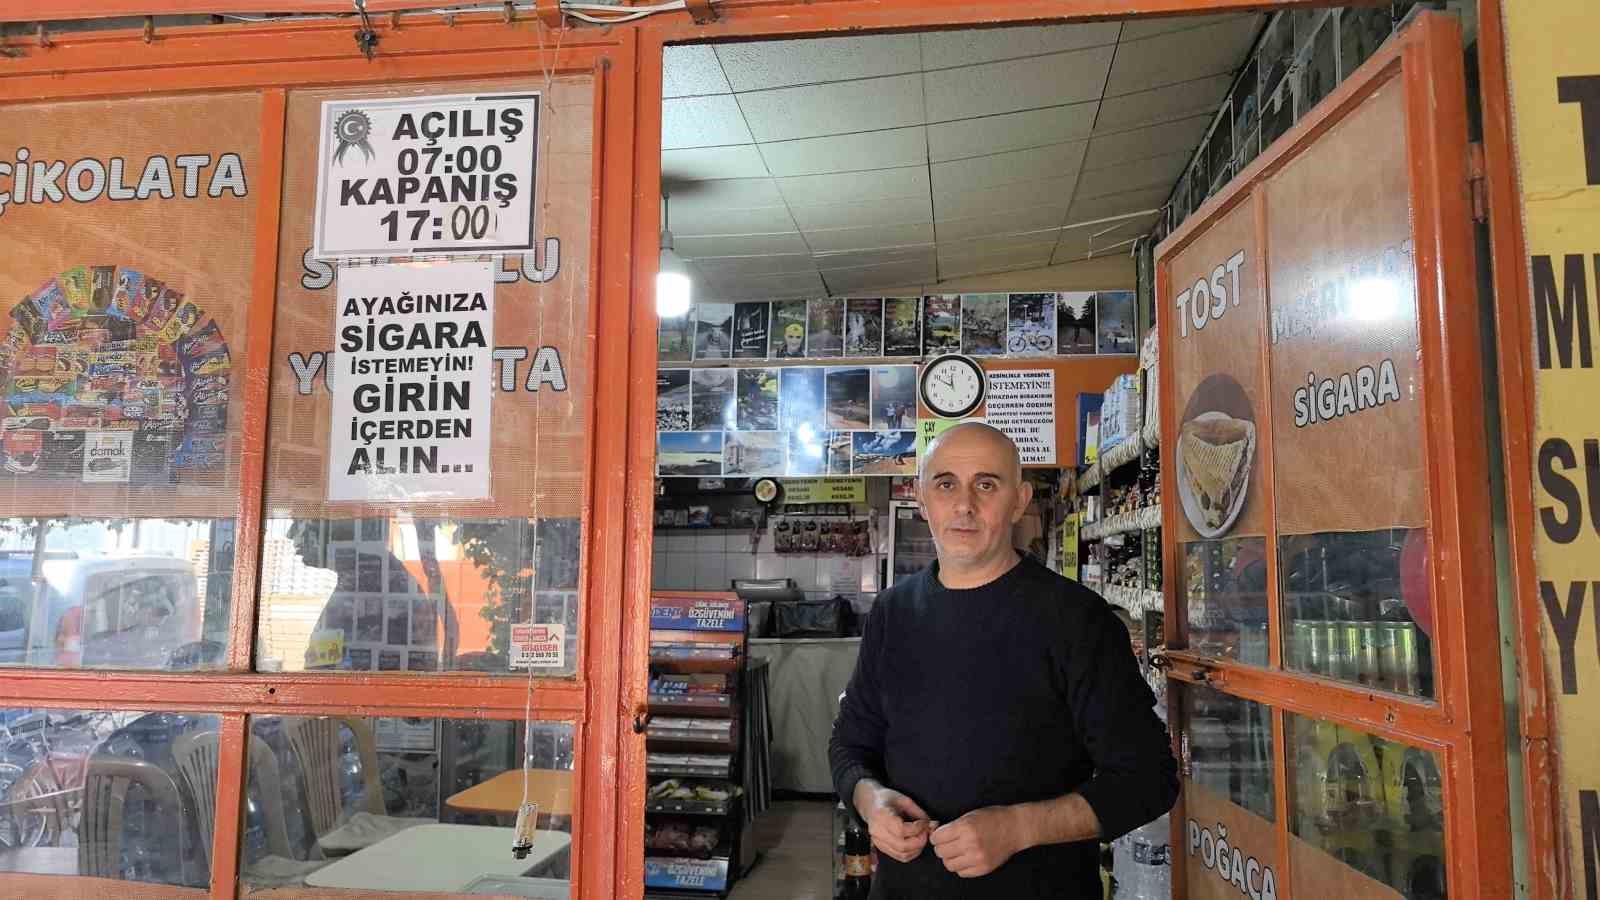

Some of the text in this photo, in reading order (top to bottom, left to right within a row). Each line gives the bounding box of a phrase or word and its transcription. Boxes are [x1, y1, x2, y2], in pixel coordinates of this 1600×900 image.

[391, 107, 524, 144] AÇILIŞ
[397, 144, 503, 176] 07:00
[340, 173, 518, 208] KAPANIŞ
[342, 291, 487, 317] AYAĞINIZA
[1175, 249, 1245, 338] TOST
[340, 317, 487, 353] SİGARA
[350, 355, 474, 376] İSTEMEYİN!
[352, 374, 471, 414] GİRİN
[1293, 357, 1401, 429] SİGARA
[351, 418, 473, 444] İÇERDEN
[346, 445, 474, 475] ALIN...
[695, 618, 724, 629] TAZELE
